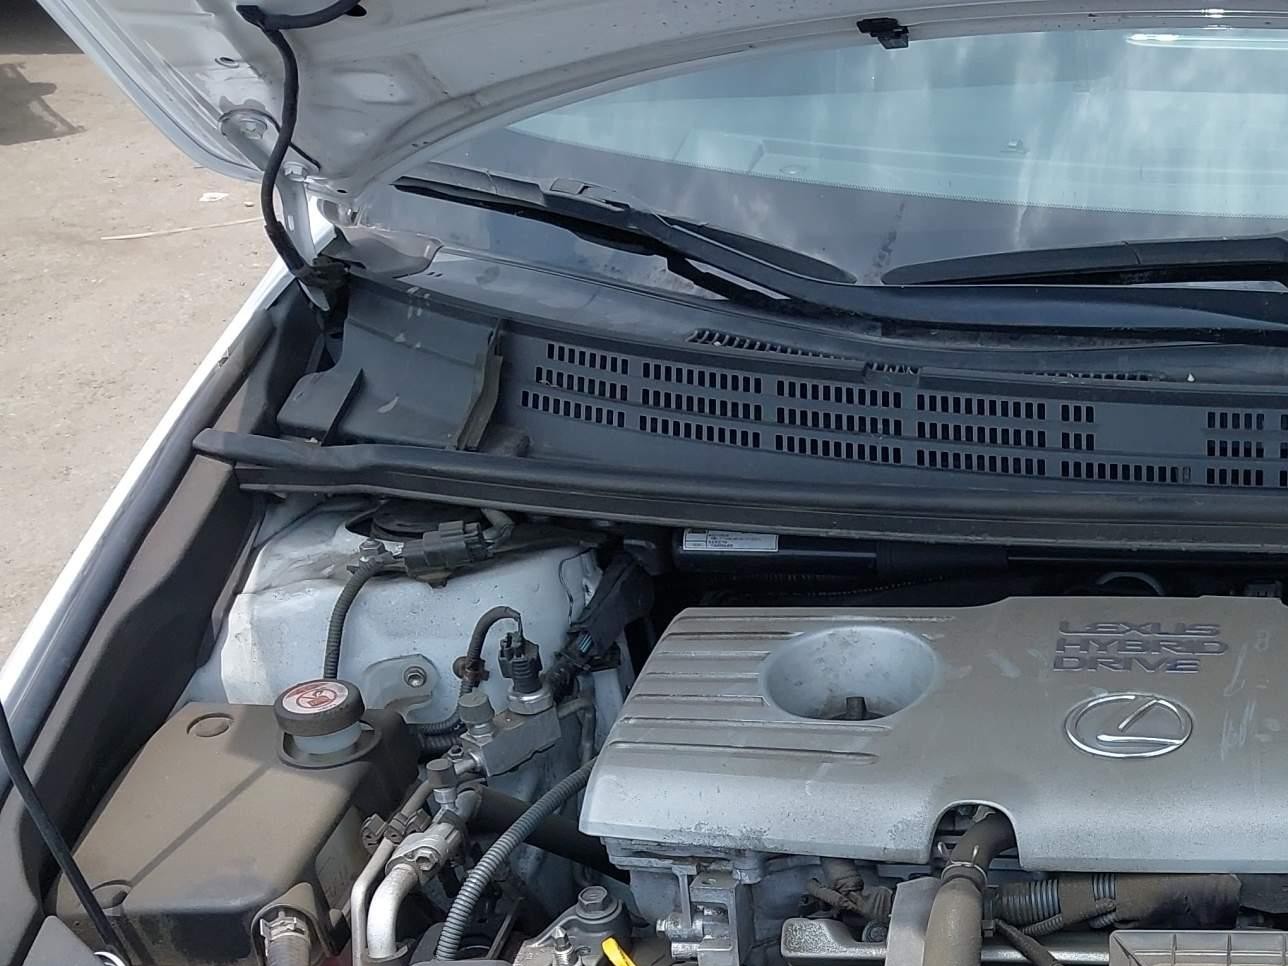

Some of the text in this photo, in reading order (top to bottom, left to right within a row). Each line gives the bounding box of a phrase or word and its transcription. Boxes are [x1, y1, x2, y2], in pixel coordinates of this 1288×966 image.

[1058, 621, 1220, 638] LEXUS
[1055, 638, 1229, 656] HYBRID
[1053, 656, 1200, 674] DRIVE
